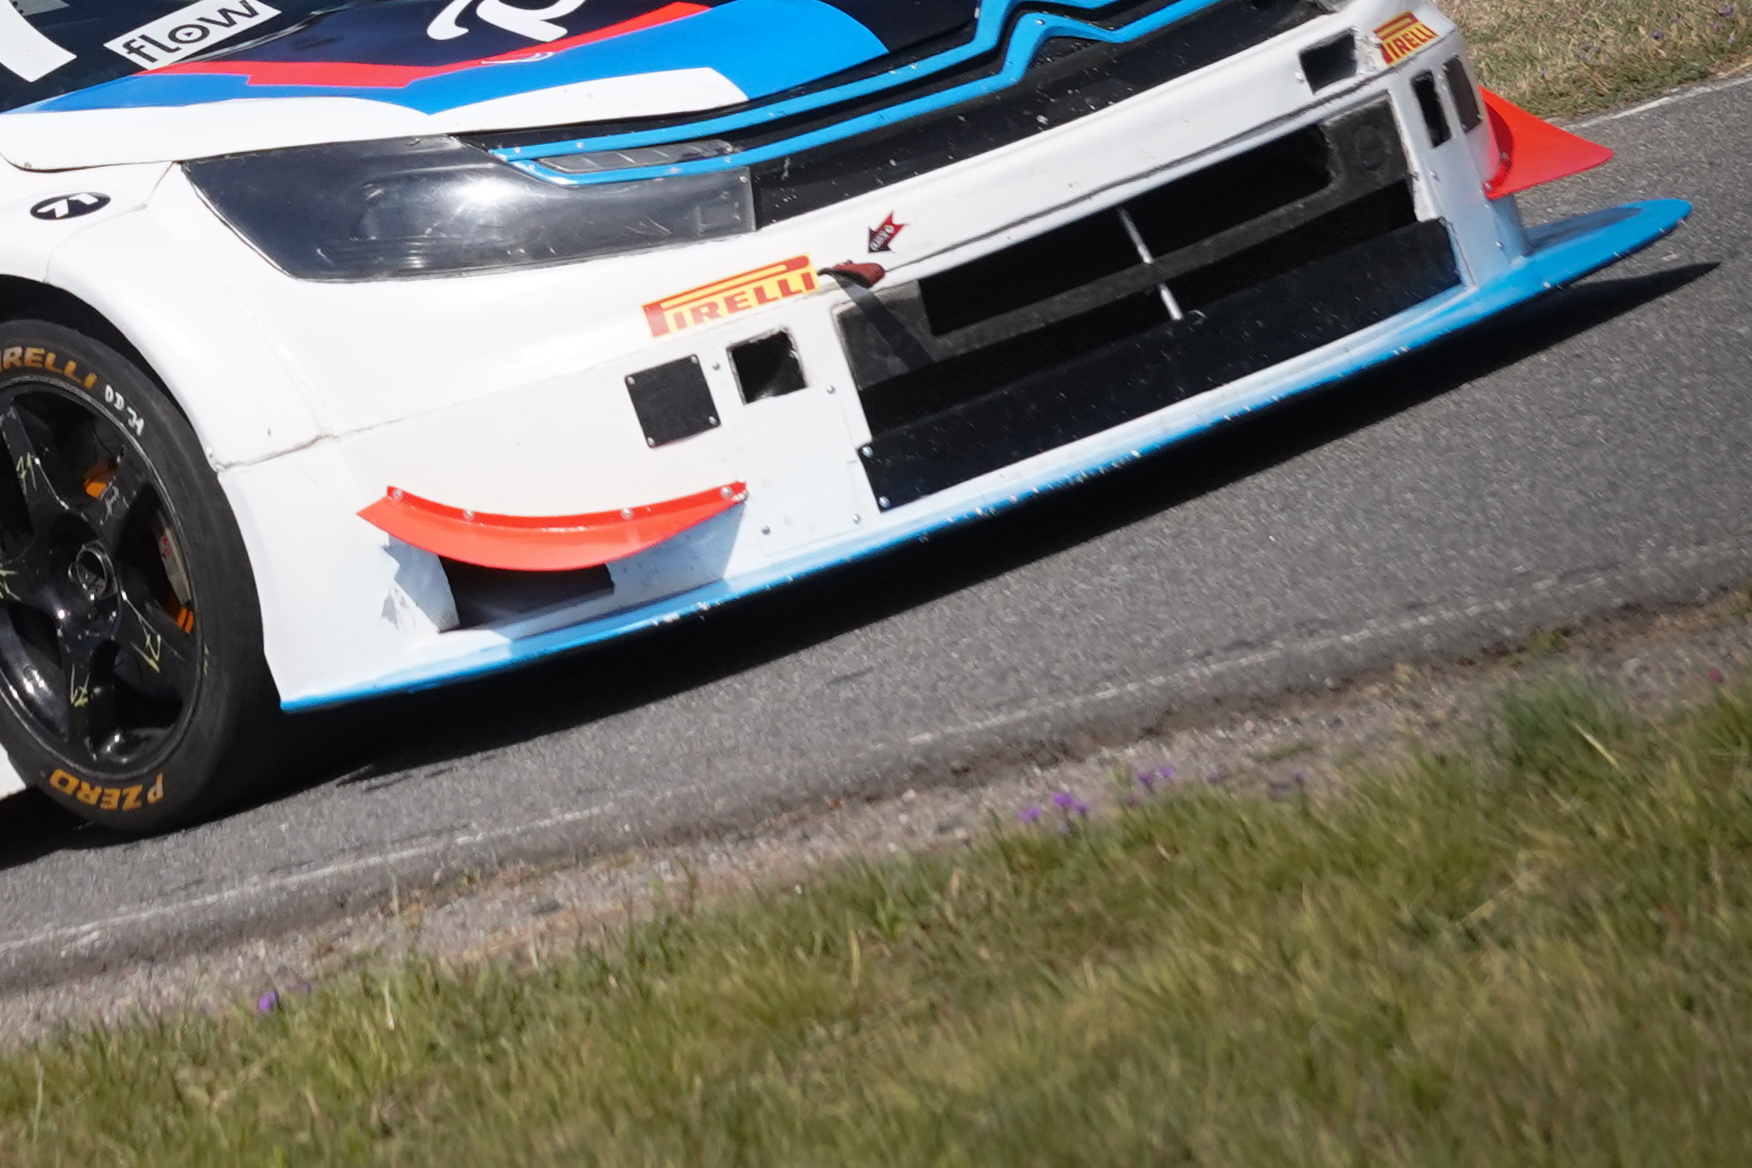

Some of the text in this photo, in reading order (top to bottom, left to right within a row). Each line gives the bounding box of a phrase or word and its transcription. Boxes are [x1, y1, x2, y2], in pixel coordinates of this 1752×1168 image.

[122, 0, 259, 63] flow
[1374, 10, 1439, 66] PIRELLI
[642, 254, 816, 338] PIRELLI
